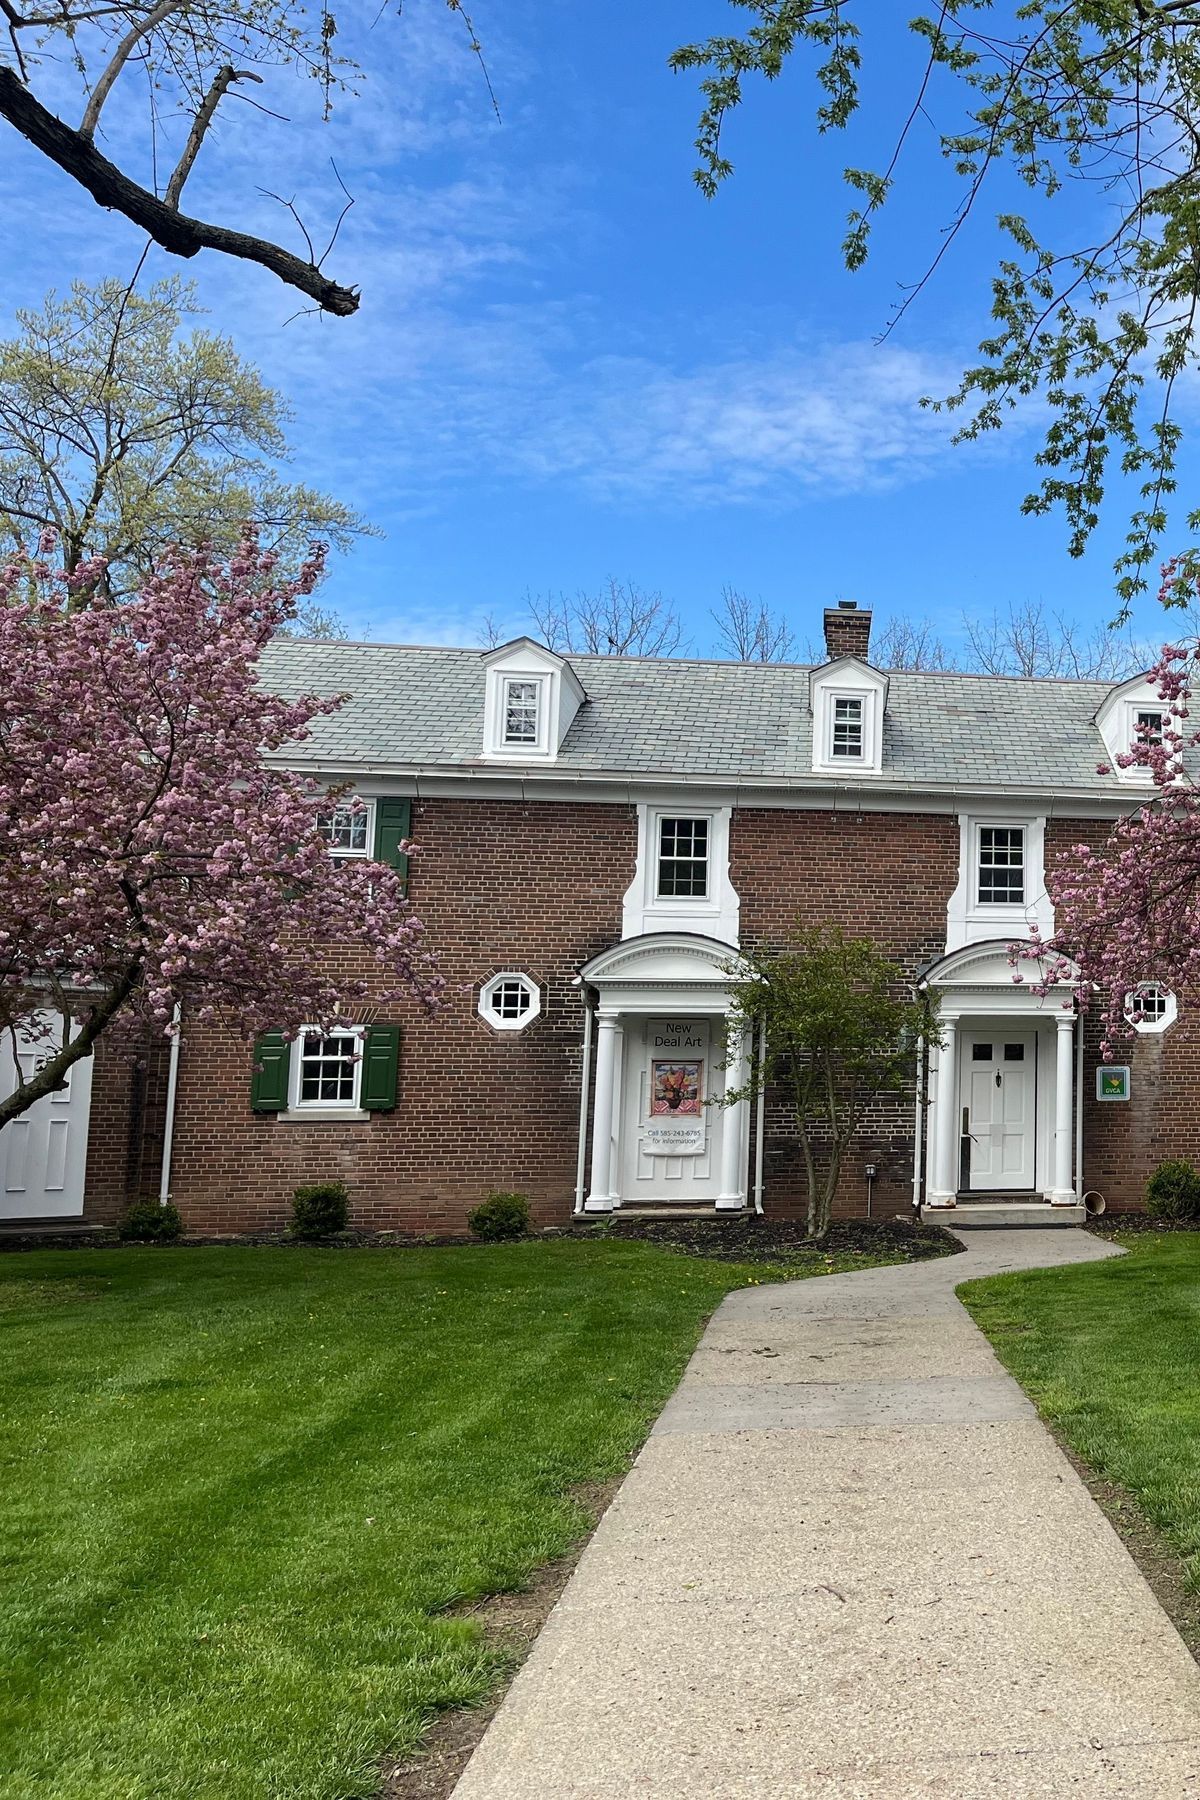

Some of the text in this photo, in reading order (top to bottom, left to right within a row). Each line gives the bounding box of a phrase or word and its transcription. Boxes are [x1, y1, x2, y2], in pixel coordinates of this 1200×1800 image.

[666, 1023, 692, 1033] New
[655, 1036, 702, 1047] Deal Art
